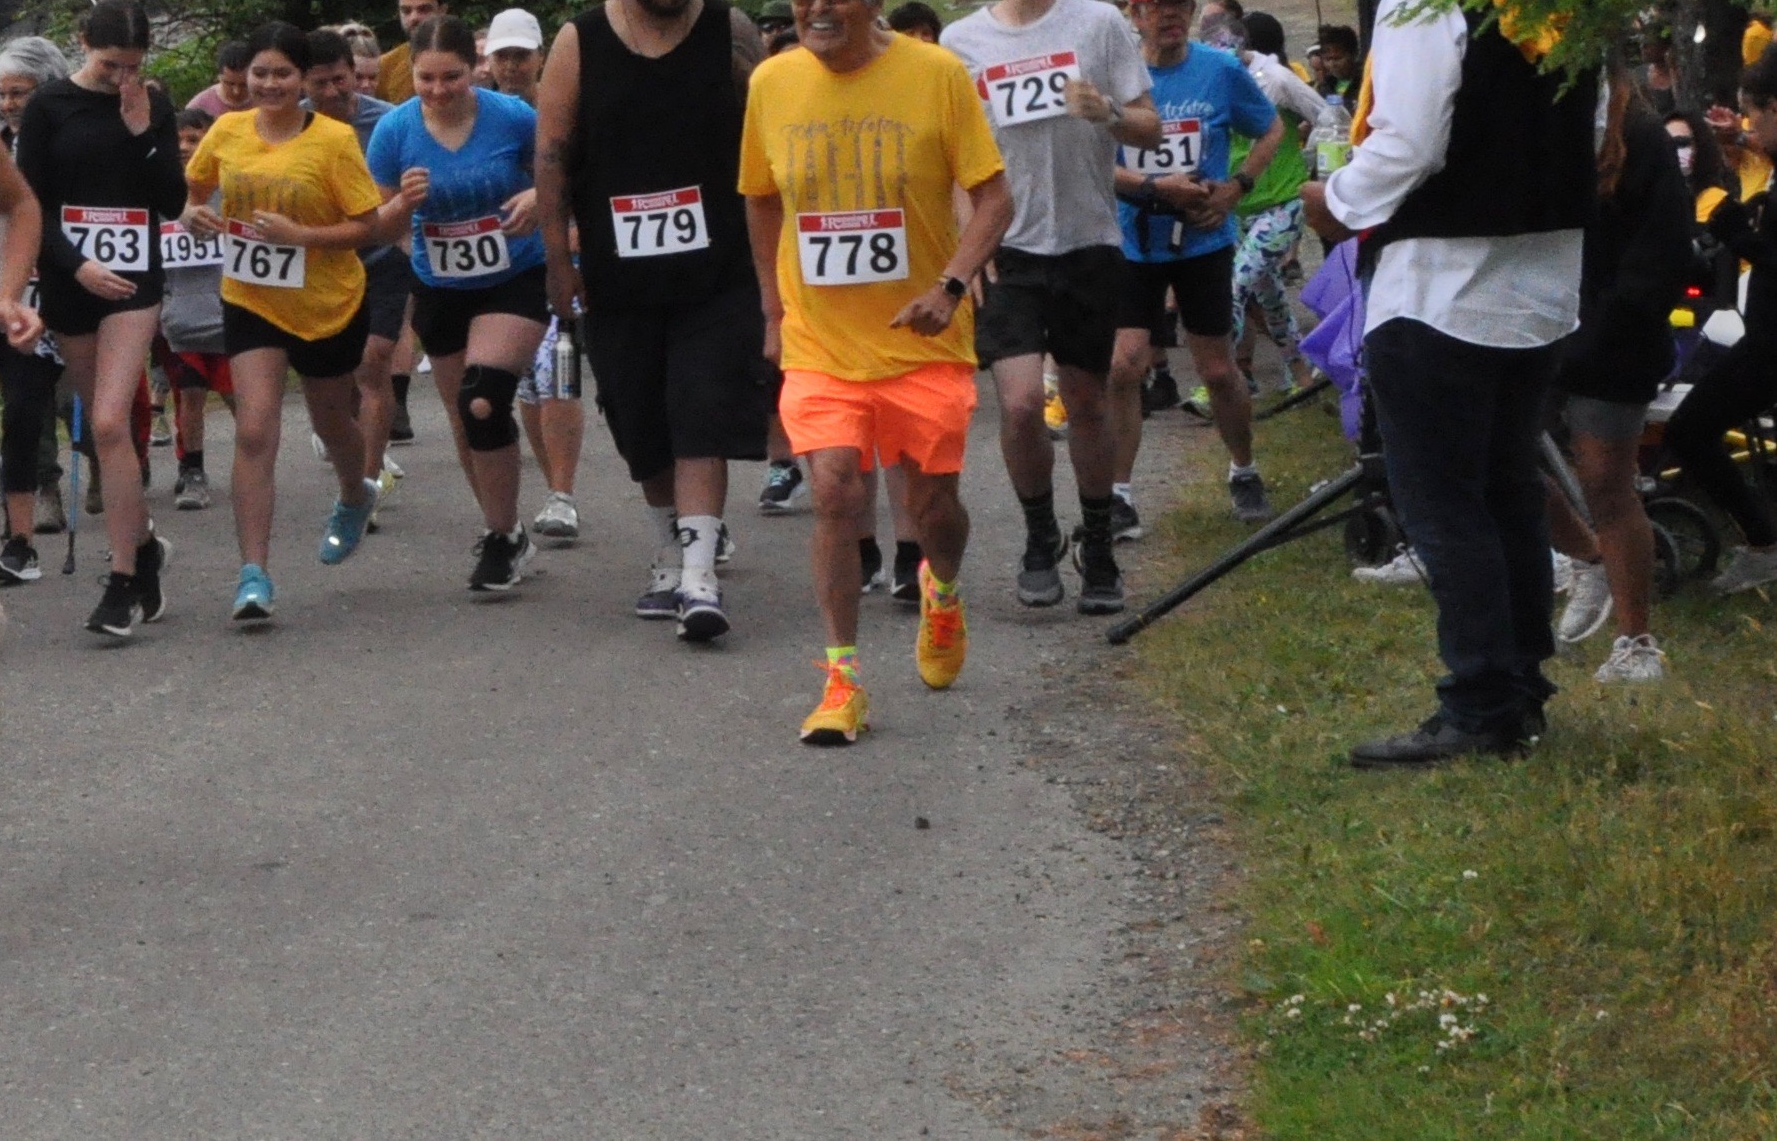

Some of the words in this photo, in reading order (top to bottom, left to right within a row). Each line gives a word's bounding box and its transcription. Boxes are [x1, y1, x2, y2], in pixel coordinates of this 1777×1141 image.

[996, 71, 1069, 117] 729
[69, 226, 140, 264] 763
[164, 235, 224, 262] 1951
[623, 208, 697, 250] 779
[232, 238, 297, 281] 767
[432, 234, 501, 272] 730
[809, 232, 899, 277] 778
